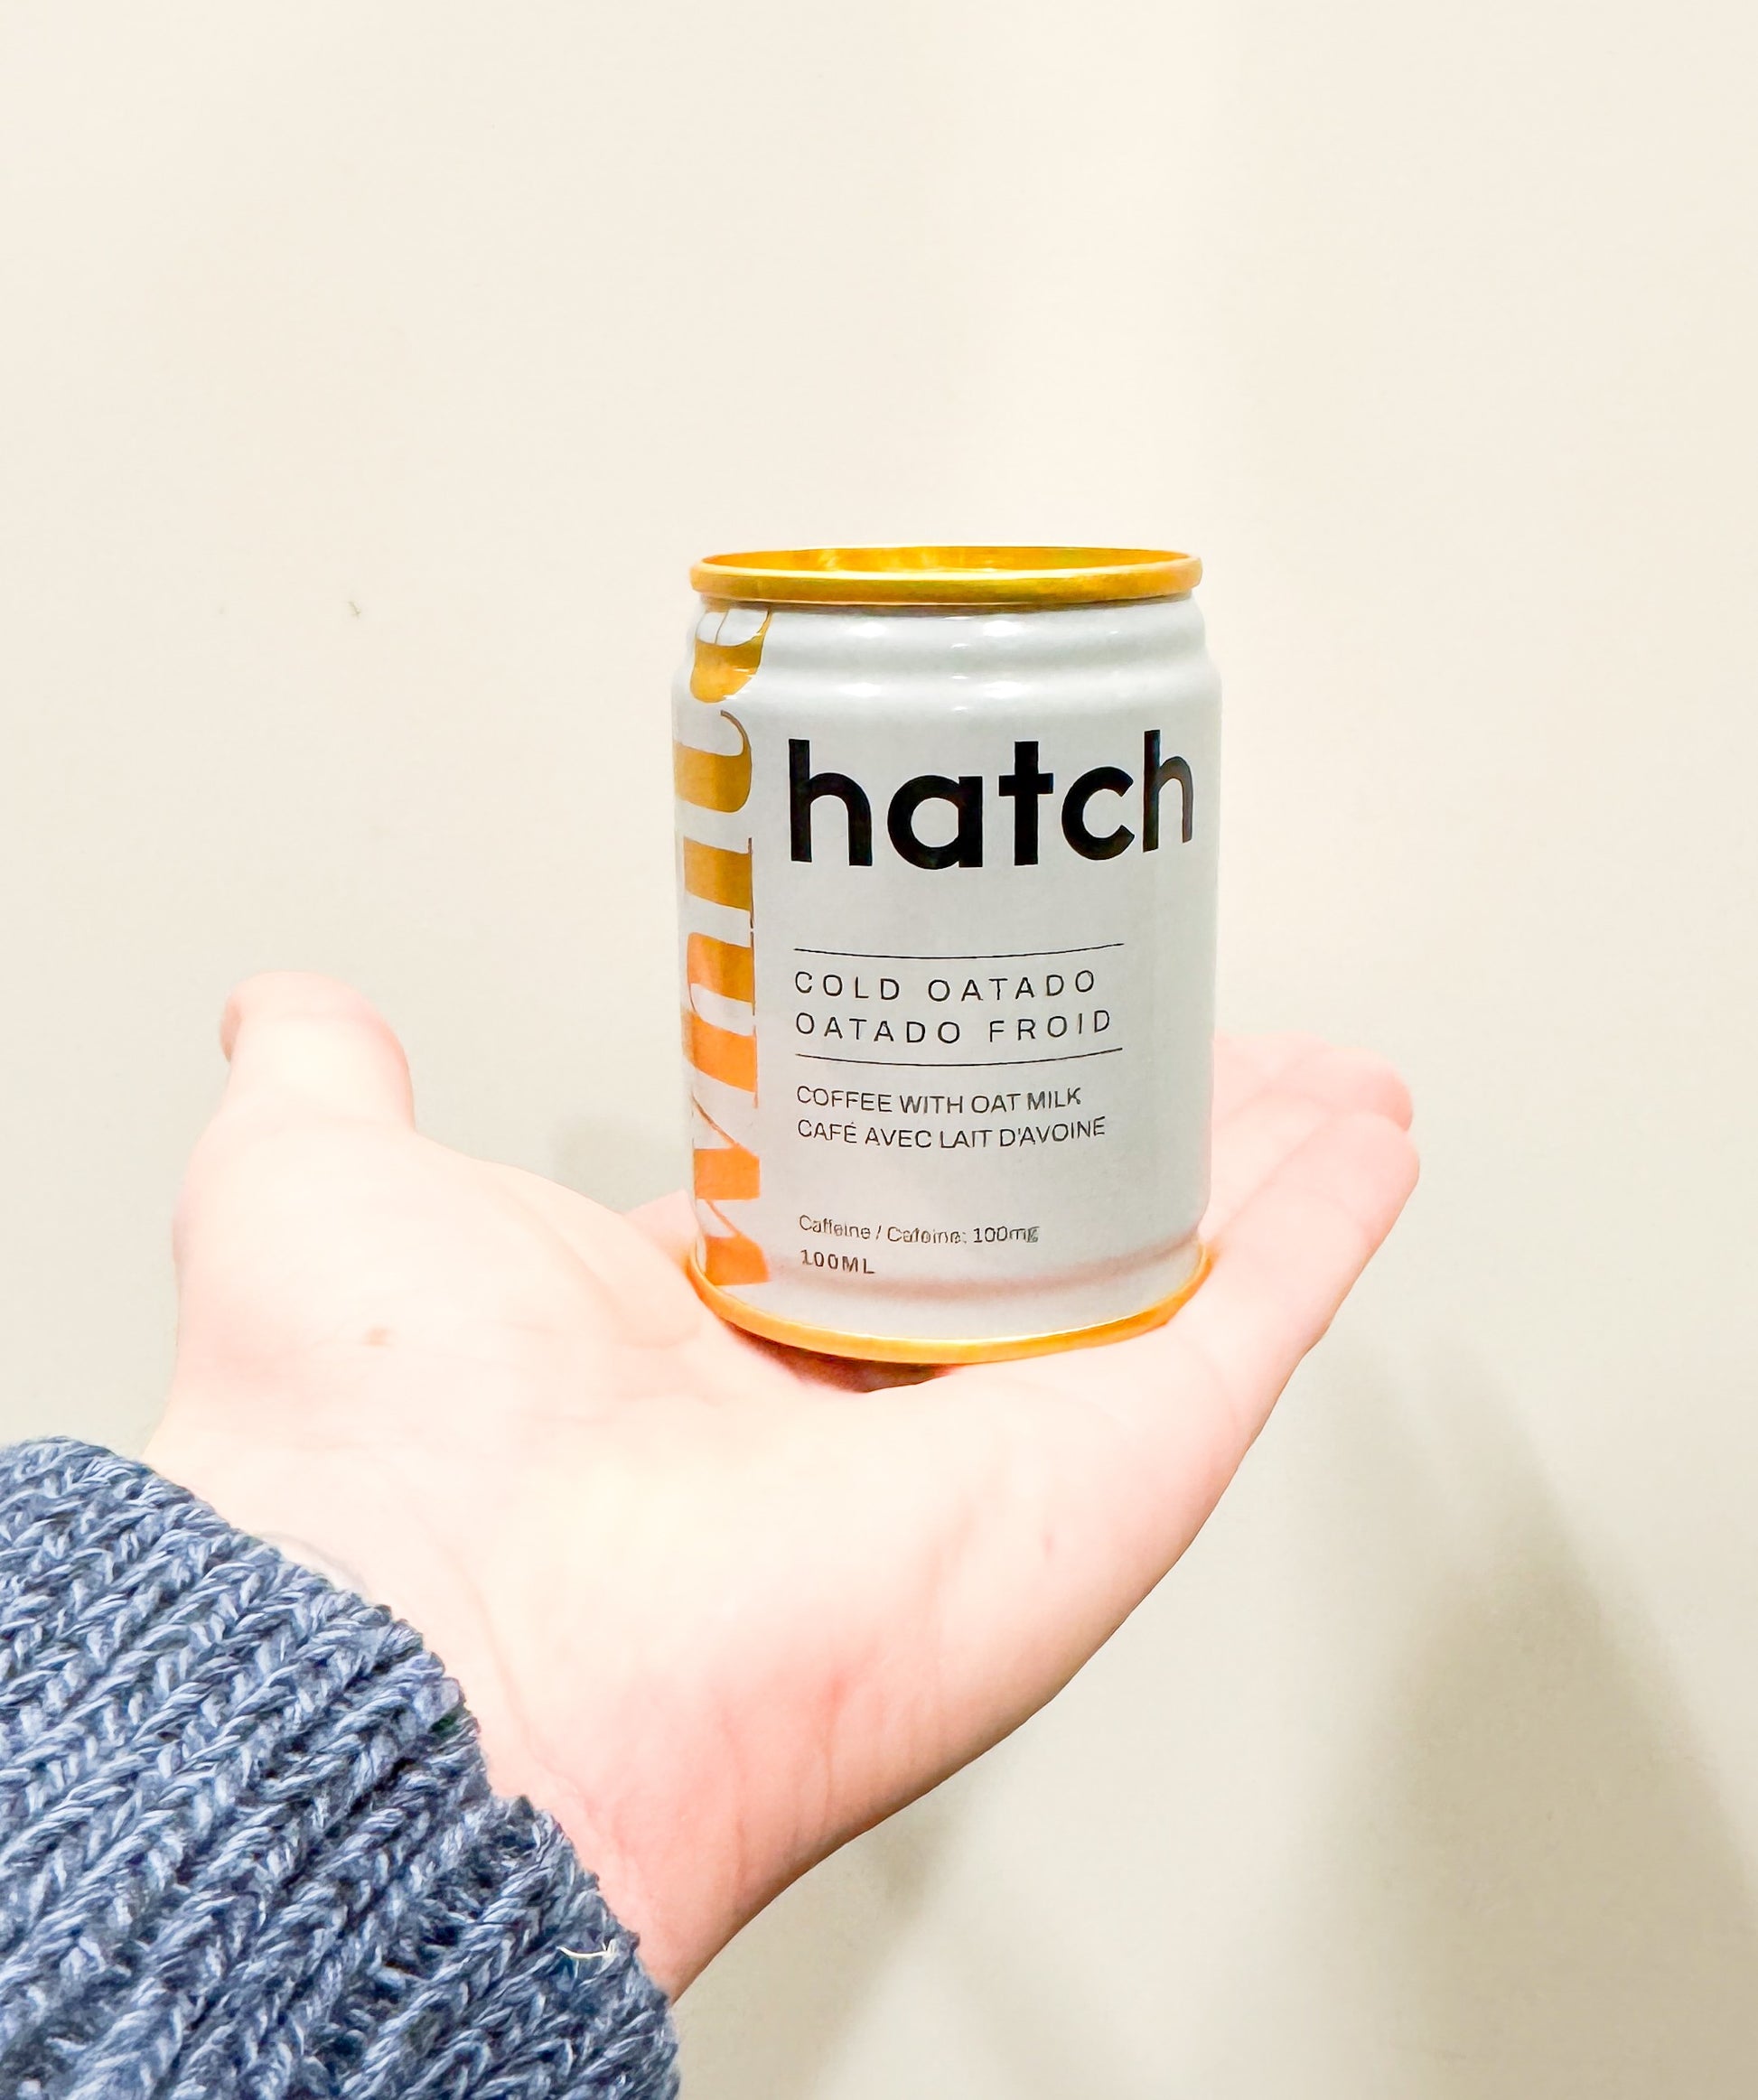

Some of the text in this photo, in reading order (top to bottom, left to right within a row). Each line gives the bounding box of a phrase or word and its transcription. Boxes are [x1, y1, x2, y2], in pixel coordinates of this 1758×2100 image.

[788, 729, 1193, 870] hatch
[794, 969, 1095, 1003] COLD OATADO
[795, 1009, 1110, 1044] OATADO FROID
[796, 1085, 1081, 1115] COFFEE WITH OAT MILK
[797, 1115, 1106, 1149] CAFÉ AVEC LAIT D'AVOINE
[799, 1214, 871, 1240] Caffeine
[800, 1248, 876, 1274] 100ML
